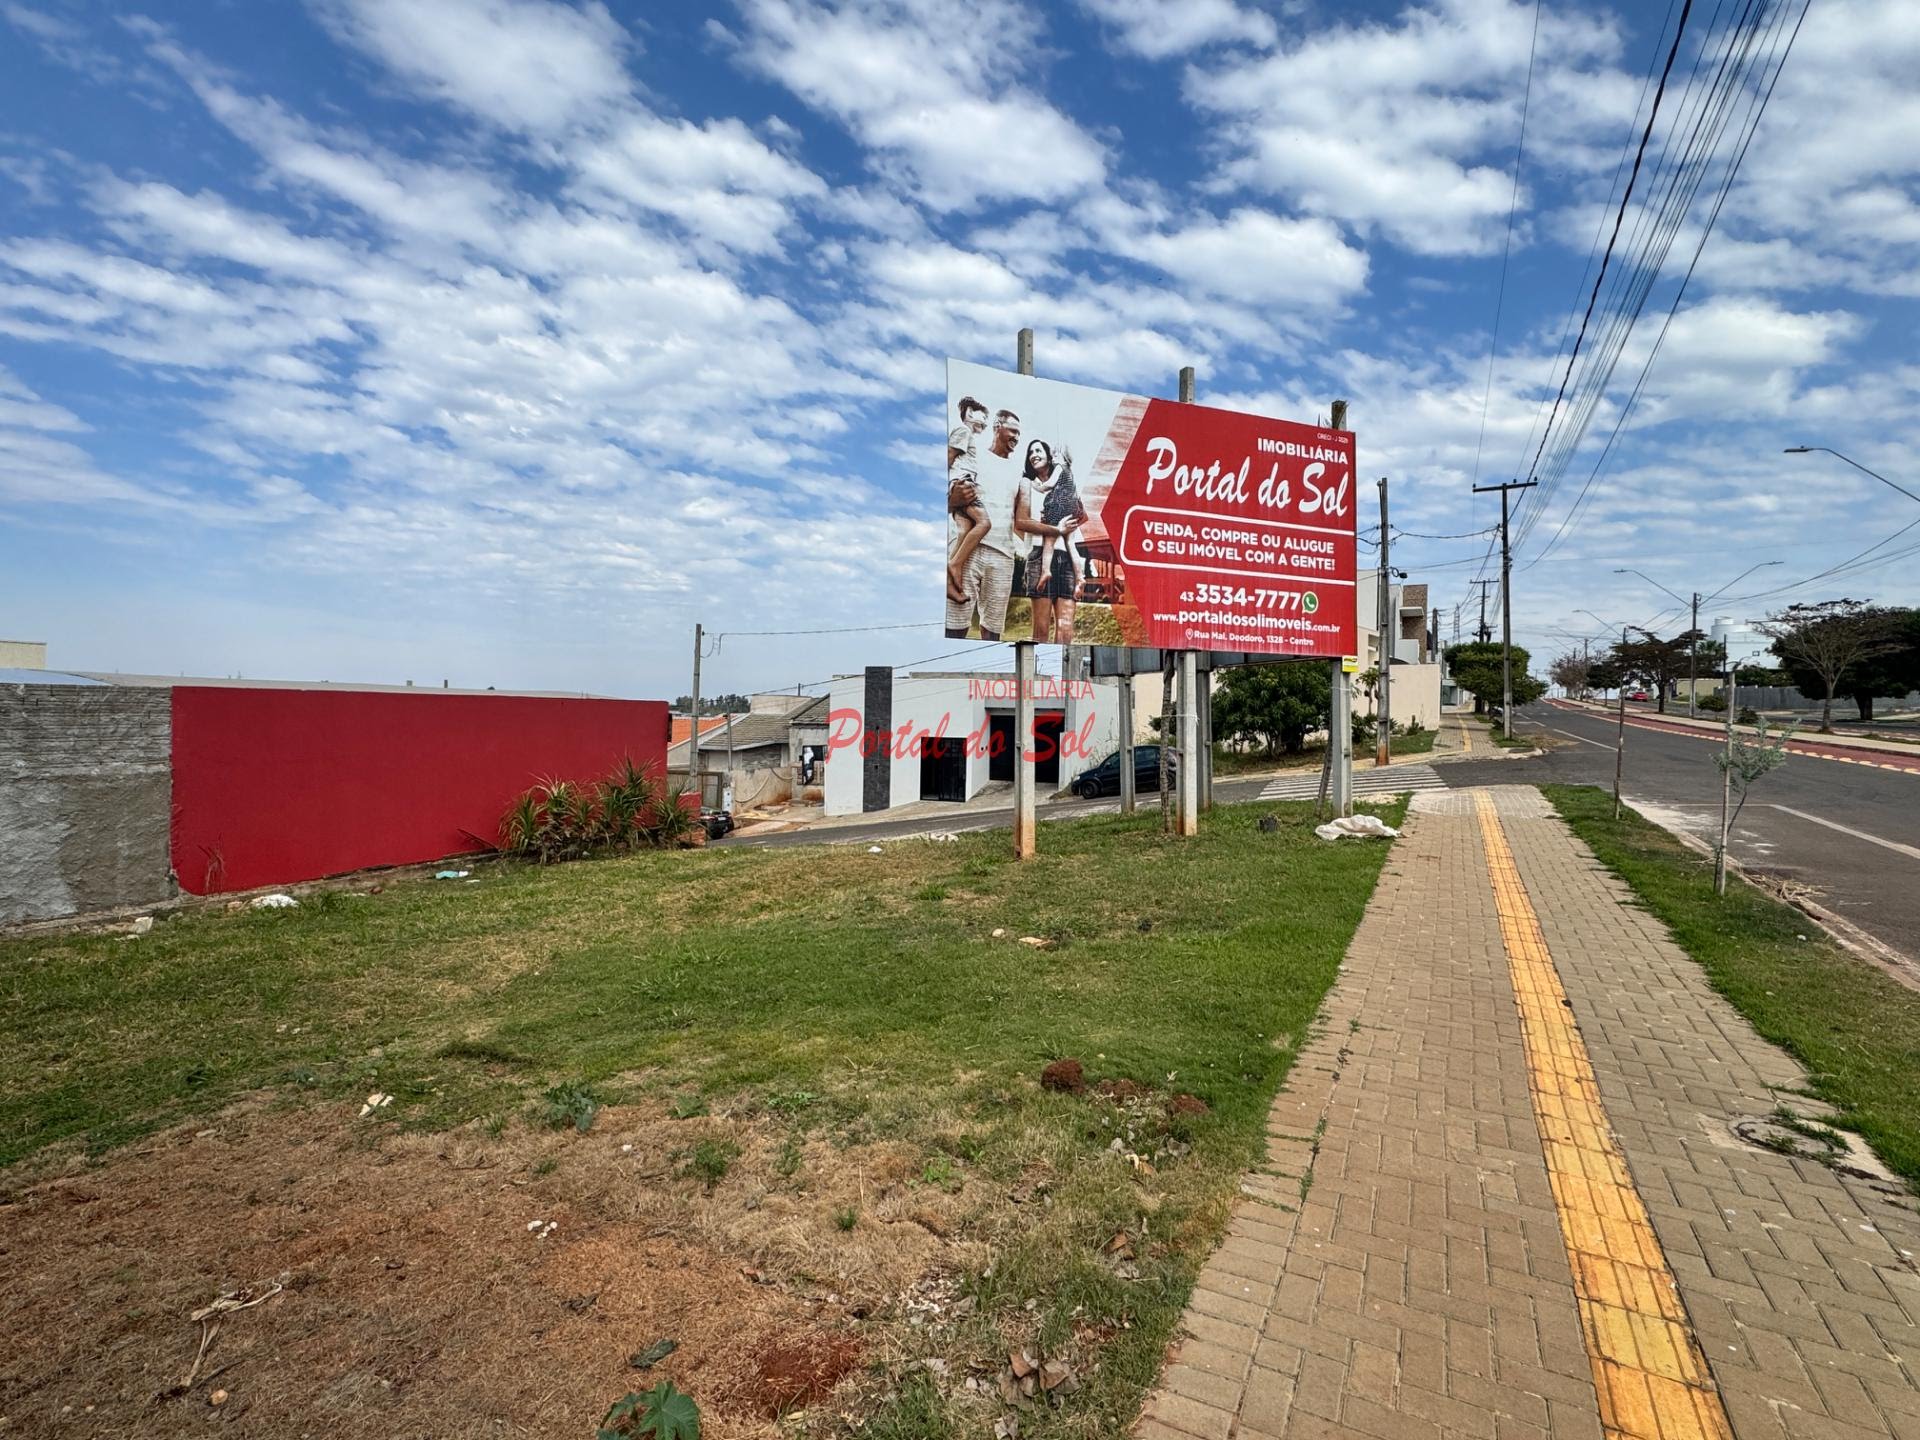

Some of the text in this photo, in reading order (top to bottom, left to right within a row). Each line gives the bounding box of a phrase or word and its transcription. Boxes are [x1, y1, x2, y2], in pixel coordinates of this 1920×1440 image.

[1257, 437, 1349, 465] IMOBILIÁRIA
[1146, 436, 1349, 516] Portal do Sol
[1143, 520, 1335, 554] VENDA, COMPRE OU ALUGUE
[1142, 539, 1335, 570] O SEU IMÓVEL COM A GENTE!
[1179, 583, 1302, 610] 43 3534-7777
[1152, 610, 1341, 632] www.portaldosolimoveis.com.br
[1194, 630, 1210, 639] Rua
[1211, 631, 1227, 641] Mal.
[1229, 633, 1265, 644] Deodoro,
[1289, 637, 1314, 646] Centro
